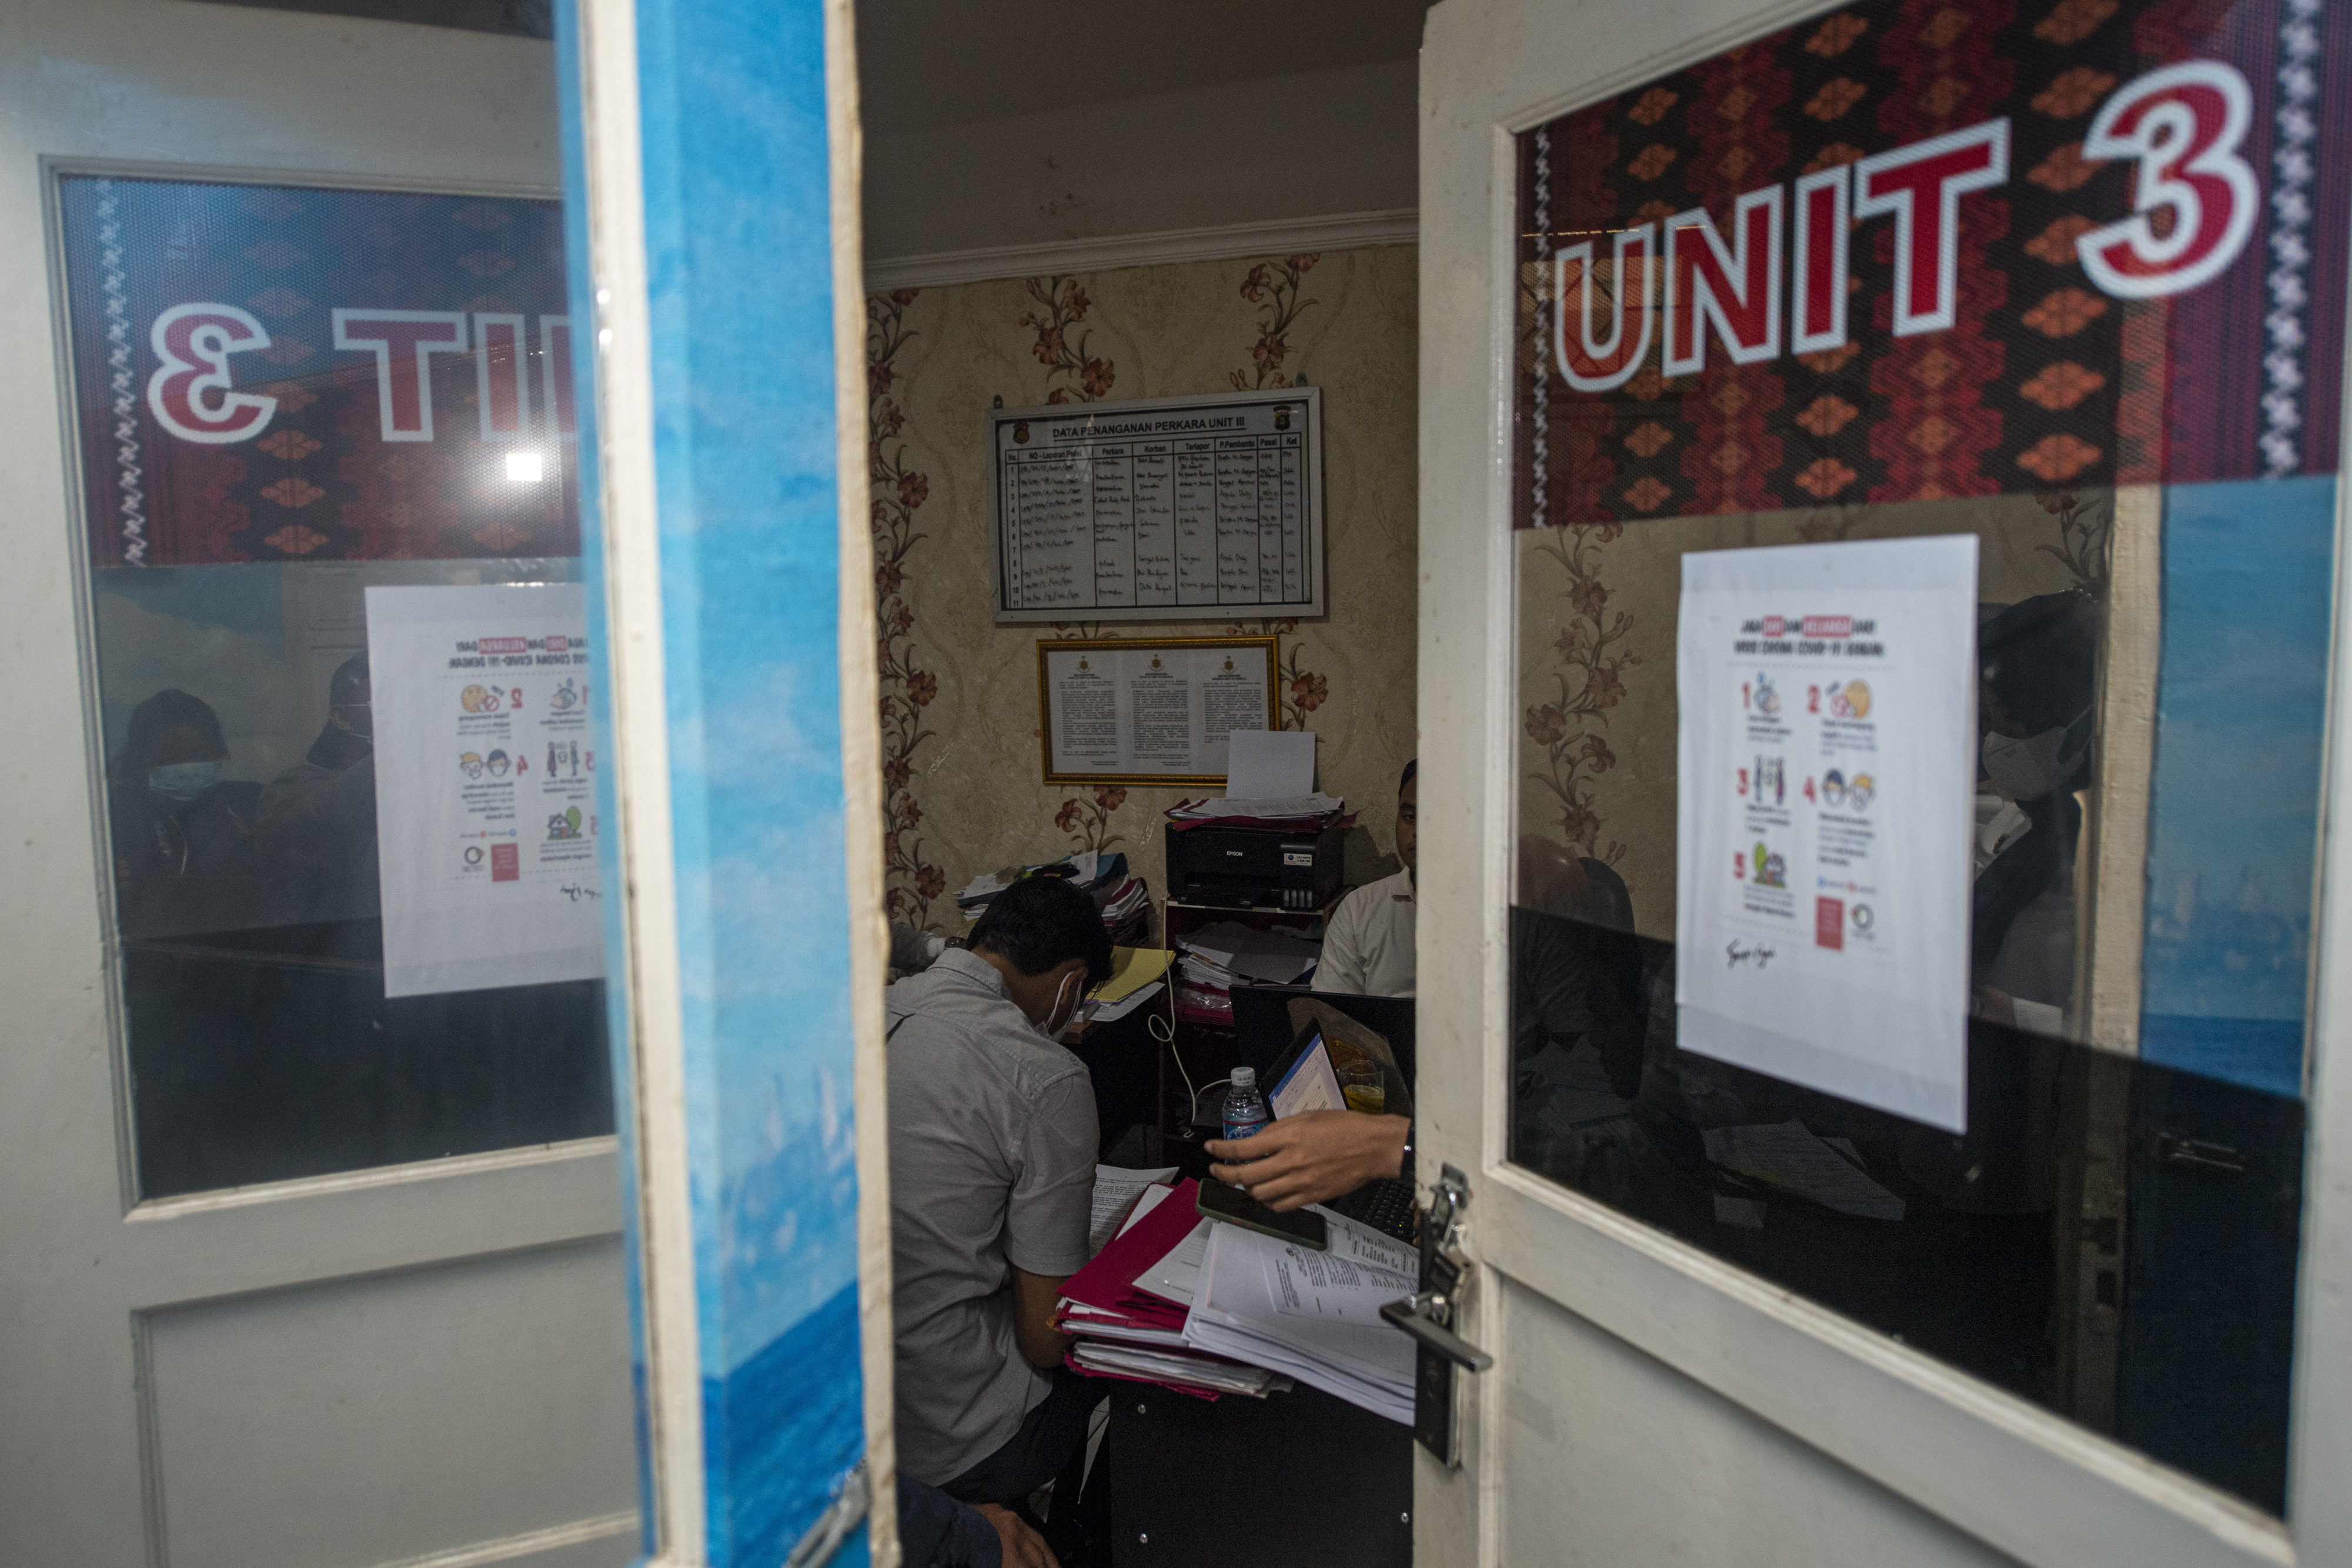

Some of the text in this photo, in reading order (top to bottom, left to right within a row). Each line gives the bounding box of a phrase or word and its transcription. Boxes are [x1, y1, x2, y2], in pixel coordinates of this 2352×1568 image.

[1554, 59, 2260, 393] UNIT 3
[1053, 417, 1245, 437] DATA PENANGANAN PERKARA UNIT III
[1220, 440, 1255, 449] P.Pembantu
[1260, 437, 1277, 446] Pasal
[1185, 443, 1211, 452] Terlapor
[1043, 452, 1065, 460] Laporan
[1807, 684, 1820, 714] 2
